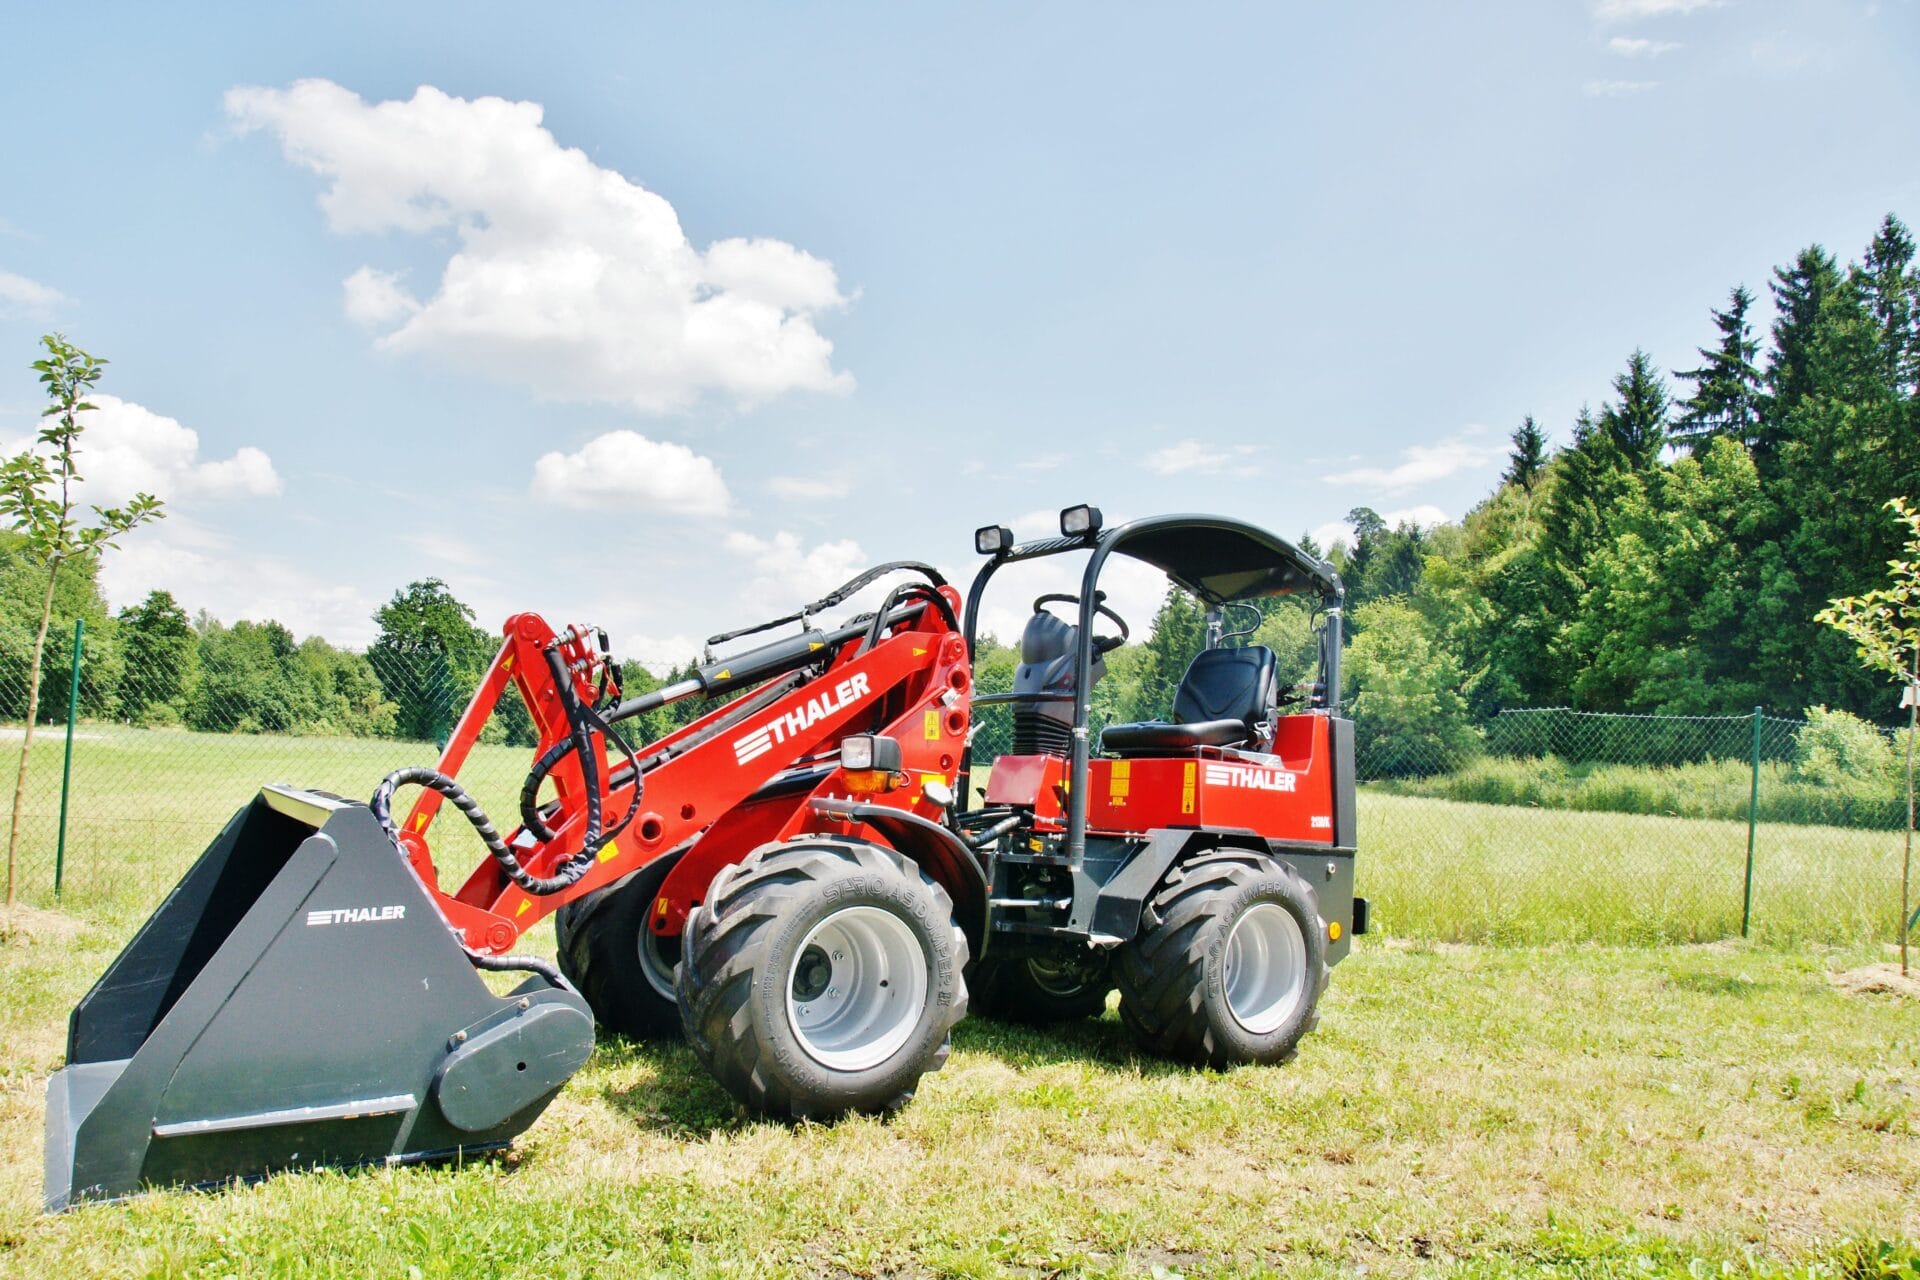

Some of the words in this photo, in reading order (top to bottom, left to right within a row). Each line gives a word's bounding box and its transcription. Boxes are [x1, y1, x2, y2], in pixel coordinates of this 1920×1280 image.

[767, 672, 871, 744] THALER
[1230, 768, 1296, 792] THALER
[332, 905, 405, 923] THALER
